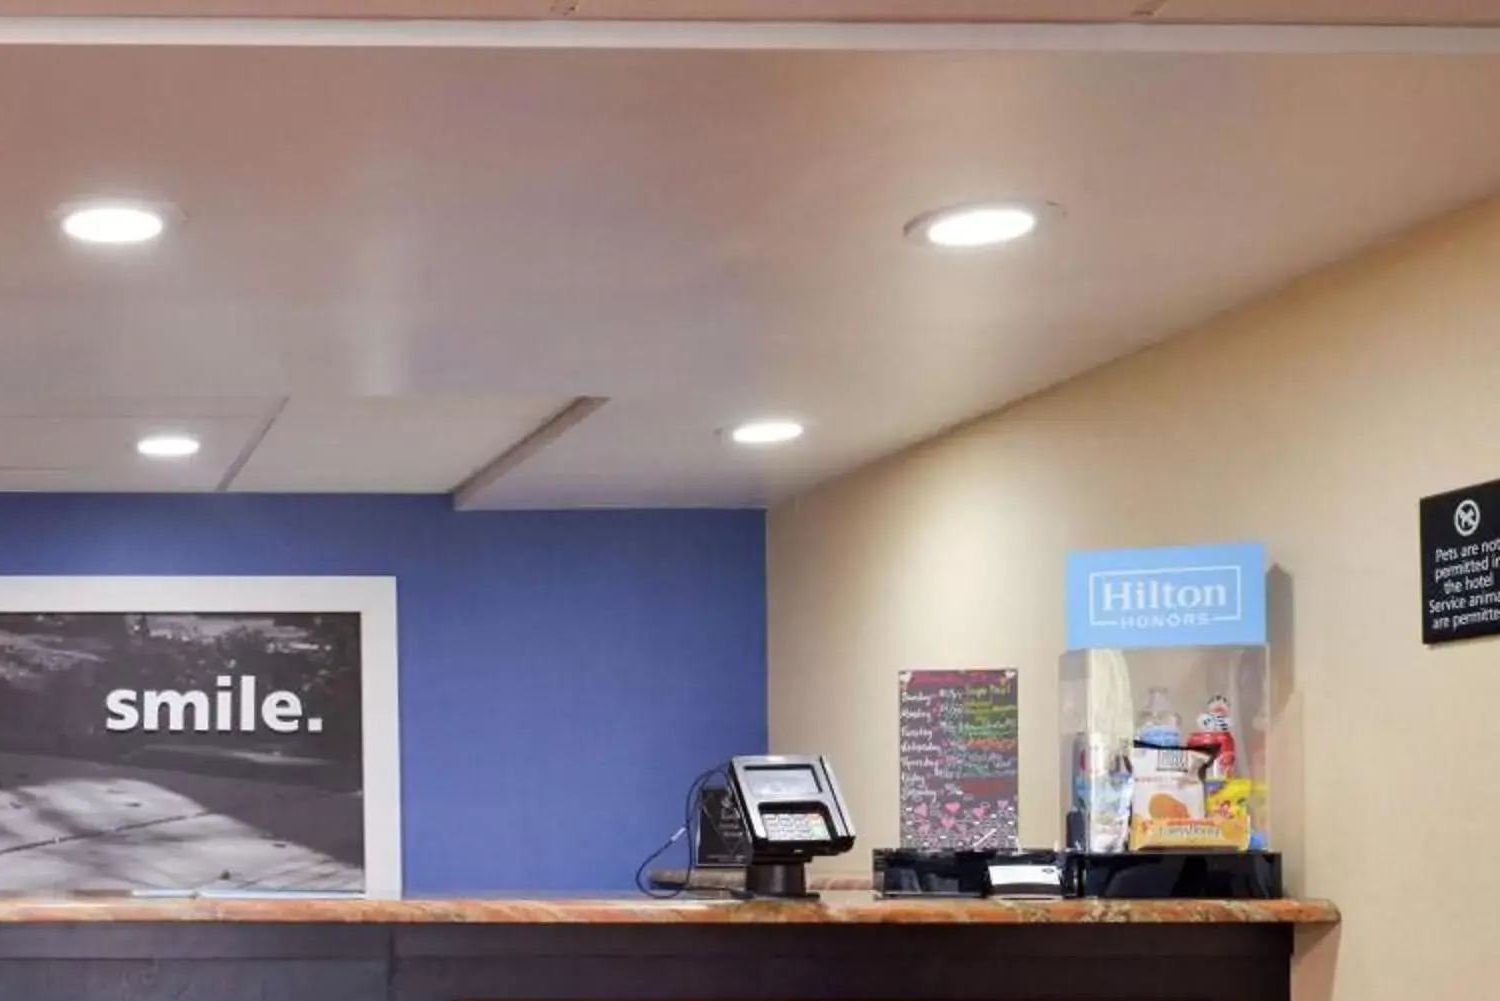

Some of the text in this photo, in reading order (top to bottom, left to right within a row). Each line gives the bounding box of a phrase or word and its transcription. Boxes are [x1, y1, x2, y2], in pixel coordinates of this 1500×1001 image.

[1435, 548, 1459, 563] Pets
[1460, 544, 1479, 557] are
[1435, 555, 1489, 583] permitted
[1443, 570, 1495, 595] the hotel
[1101, 579, 1228, 613] Hilton
[1428, 595, 1467, 614] Service
[1120, 612, 1211, 630] HONORS
[1432, 616, 1451, 630] are
[106, 675, 323, 732] smile.
